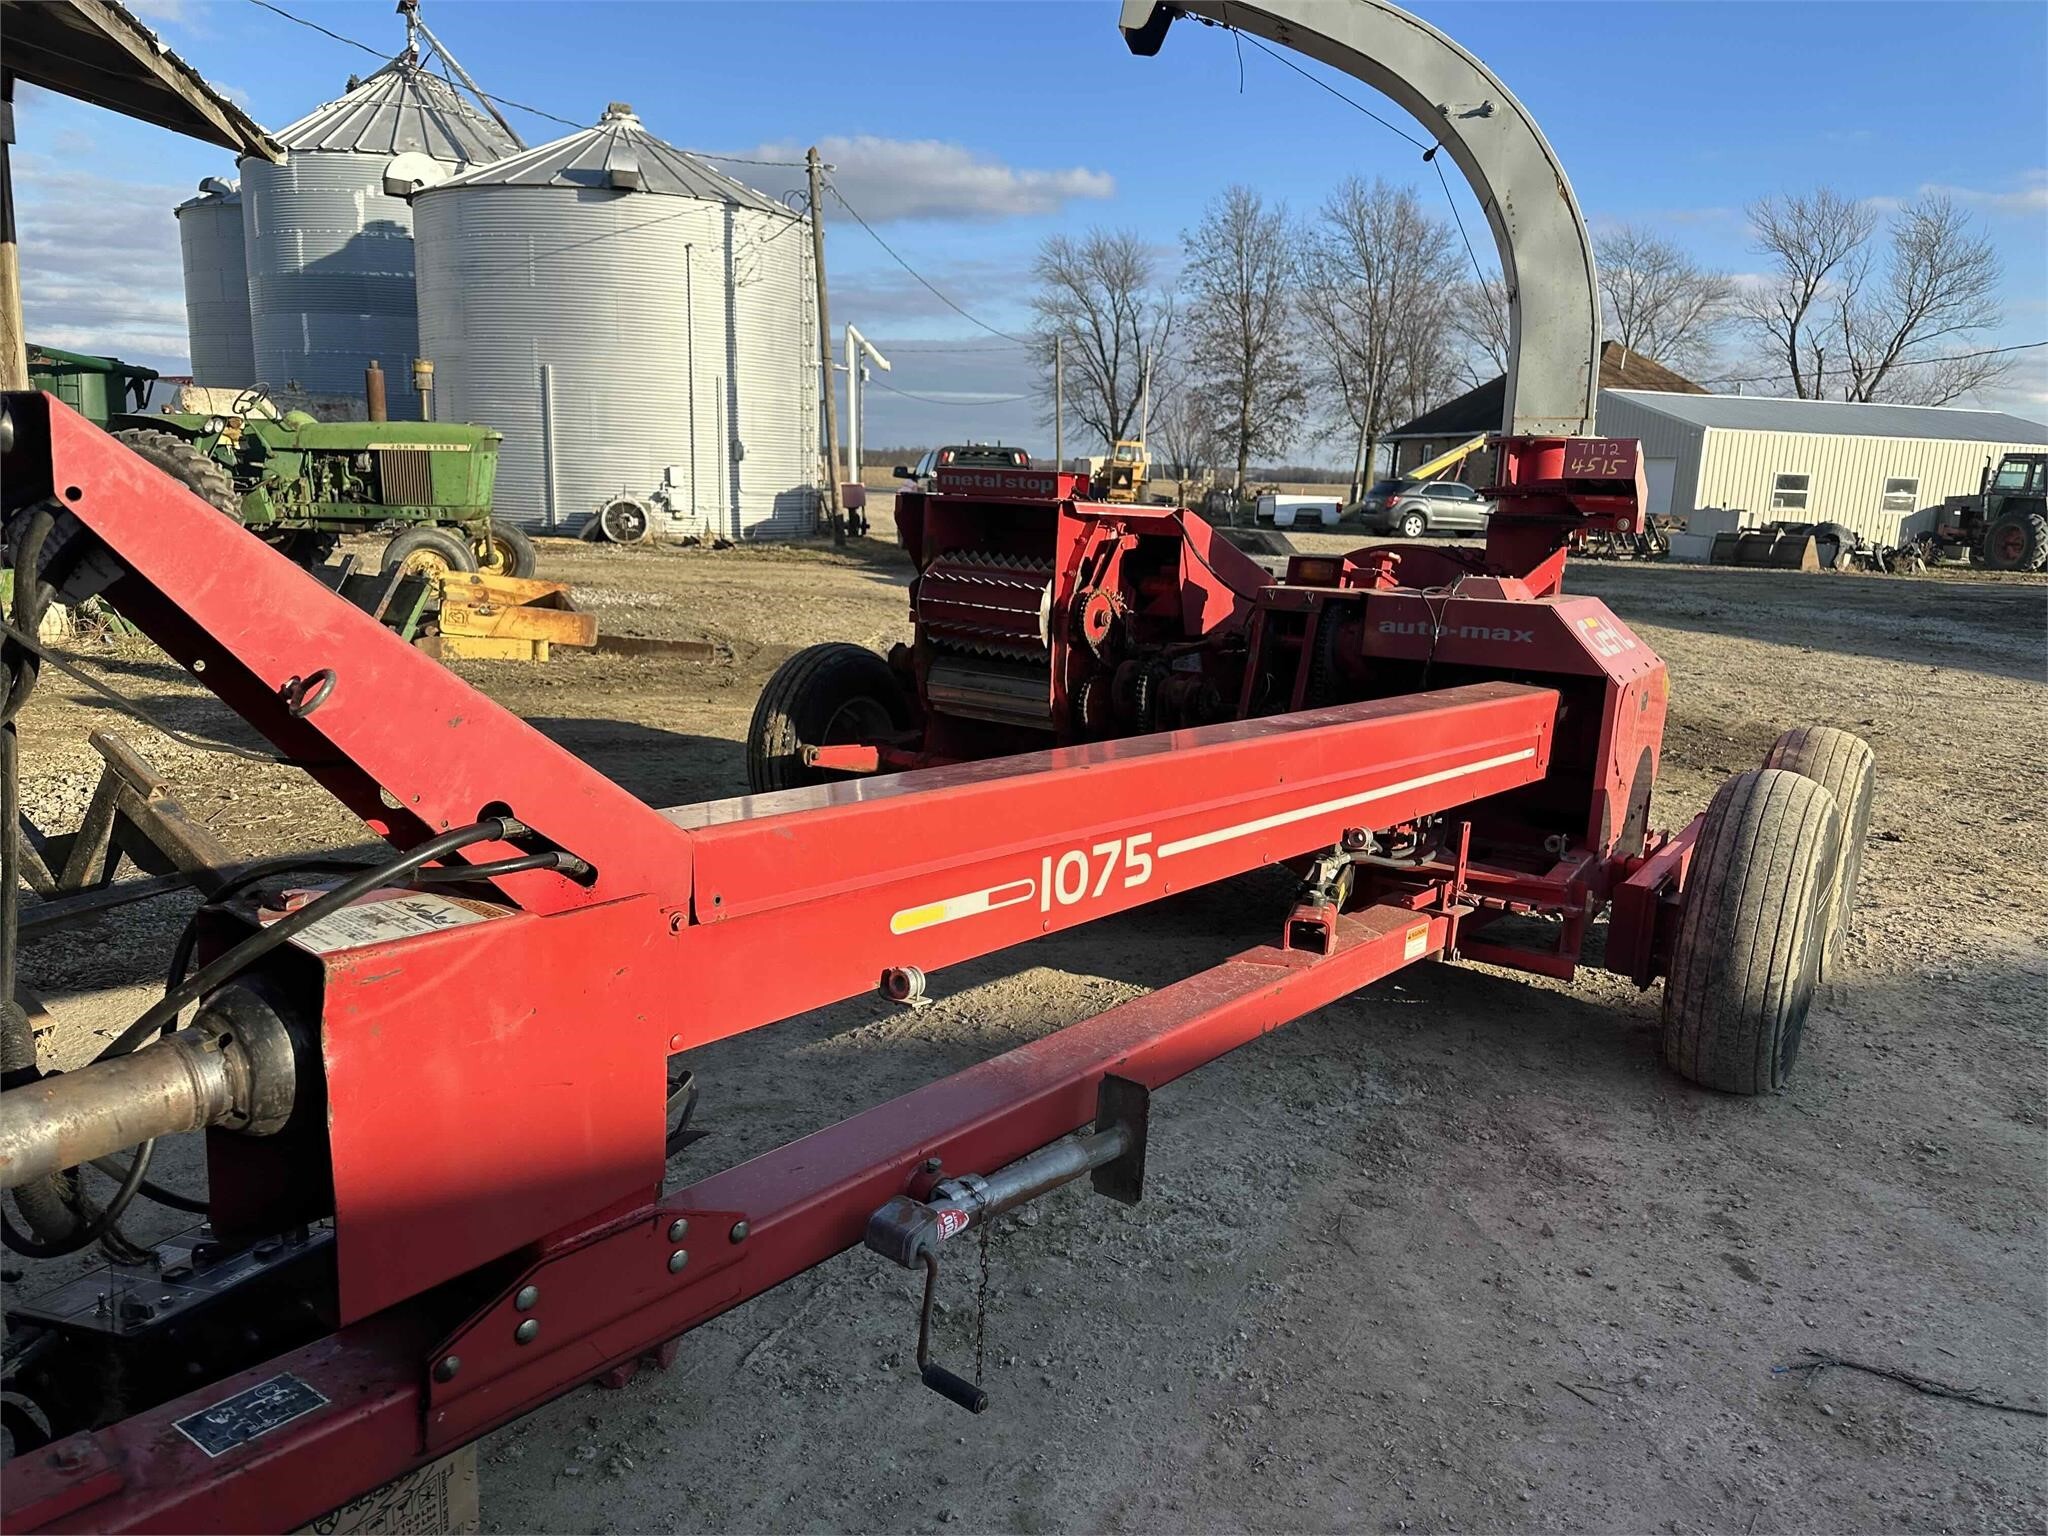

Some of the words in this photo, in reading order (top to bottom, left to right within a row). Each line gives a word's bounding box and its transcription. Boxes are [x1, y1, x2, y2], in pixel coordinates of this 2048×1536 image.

[1577, 443, 1620, 455] 7172
[1571, 457, 1627, 475] 4515
[941, 473, 1000, 488] metal
[1005, 475, 1054, 493] stop
[1378, 620, 1535, 643] auto-max
[1040, 831, 1153, 913] 1075
